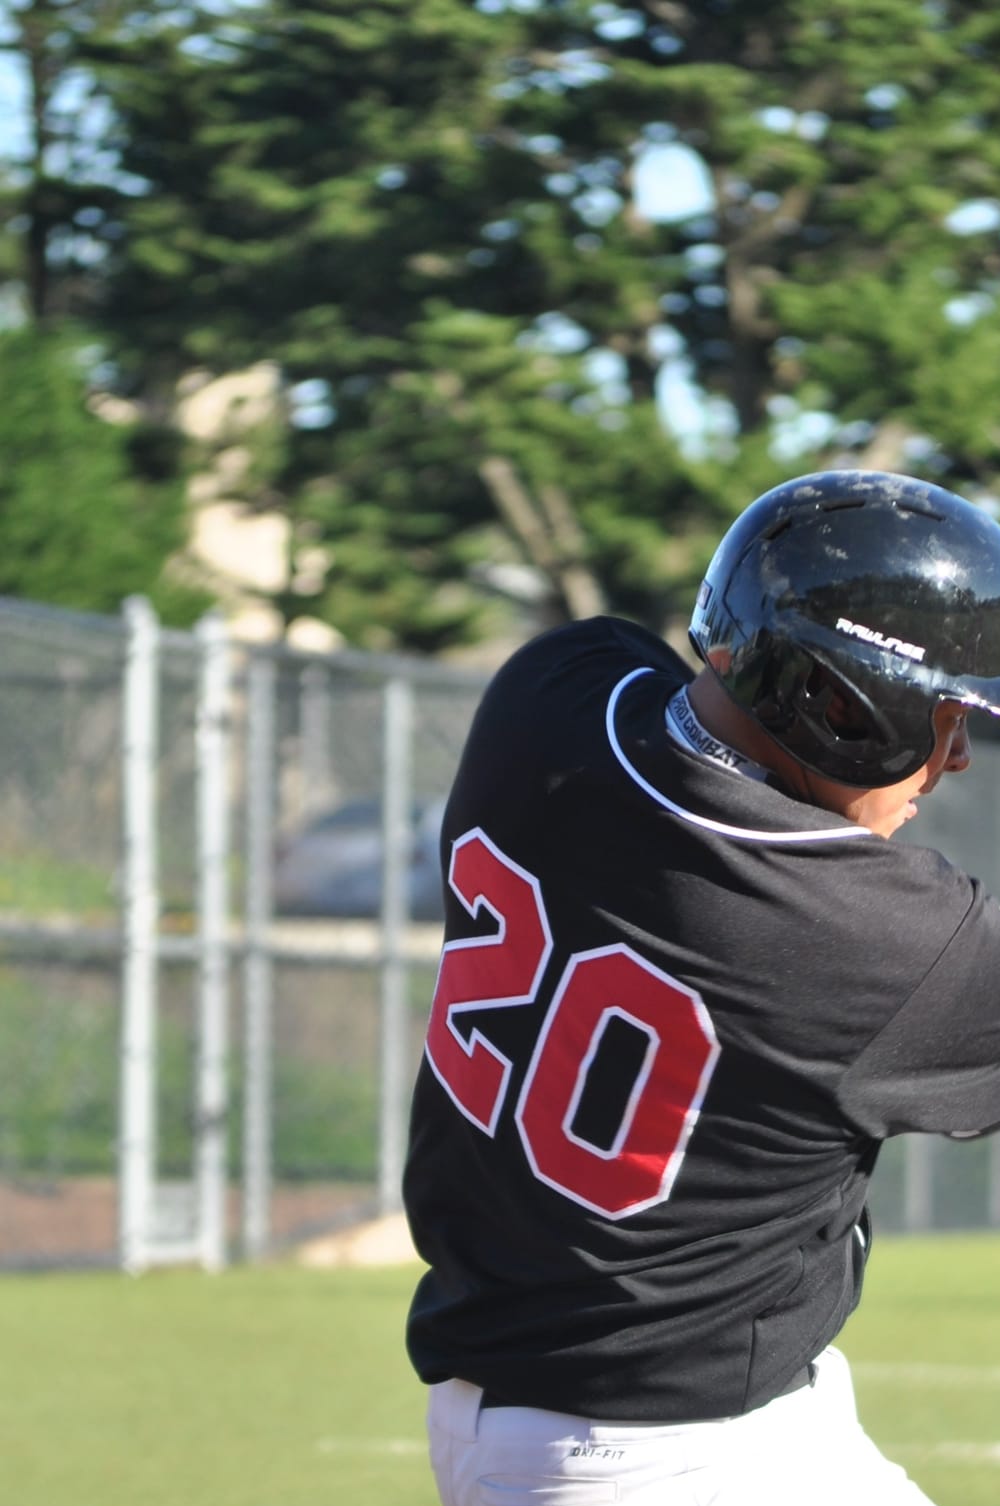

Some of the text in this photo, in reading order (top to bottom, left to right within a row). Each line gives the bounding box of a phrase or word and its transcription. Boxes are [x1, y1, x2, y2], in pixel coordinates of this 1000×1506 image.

[684, 716, 748, 768] COMBAT
[424, 826, 722, 1221] 20
[570, 1447, 625, 1460] DRI-FIT
